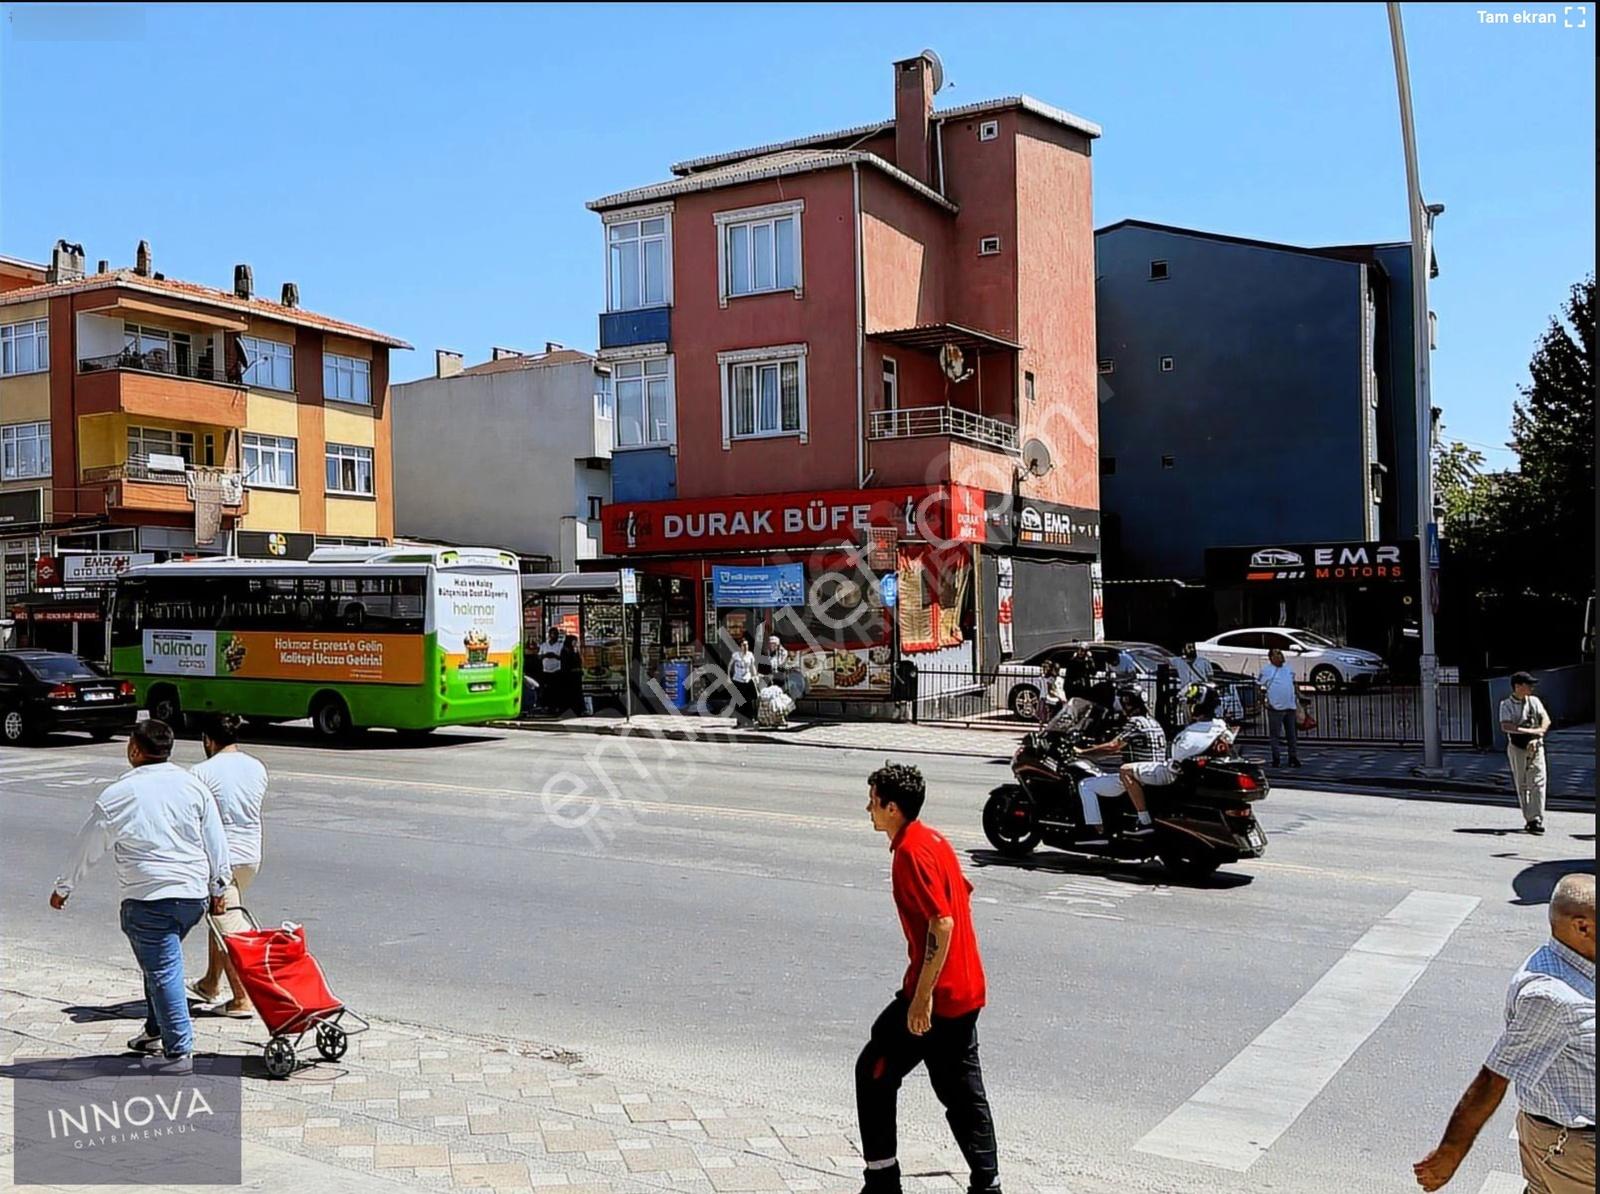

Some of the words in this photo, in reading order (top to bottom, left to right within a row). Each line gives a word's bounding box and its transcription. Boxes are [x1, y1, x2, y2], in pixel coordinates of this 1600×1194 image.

[664, 510, 773, 538] DURAK
[784, 500, 871, 533] BÜFE
[1044, 512, 1070, 533] EMR
[84, 556, 130, 567] EMRAH
[1315, 546, 1400, 566] EMR
[1316, 567, 1401, 578] MOTORS
[453, 602, 495, 616] hakmar
[152, 639, 208, 656] hakmar
[275, 638, 311, 650] Hakmar
[313, 639, 355, 652] Express'e
[357, 640, 383, 652] Gelin
[280, 652, 315, 666] Kaliteyi
[316, 653, 345, 665] Ucuza
[346, 654, 383, 666] Getirin!
